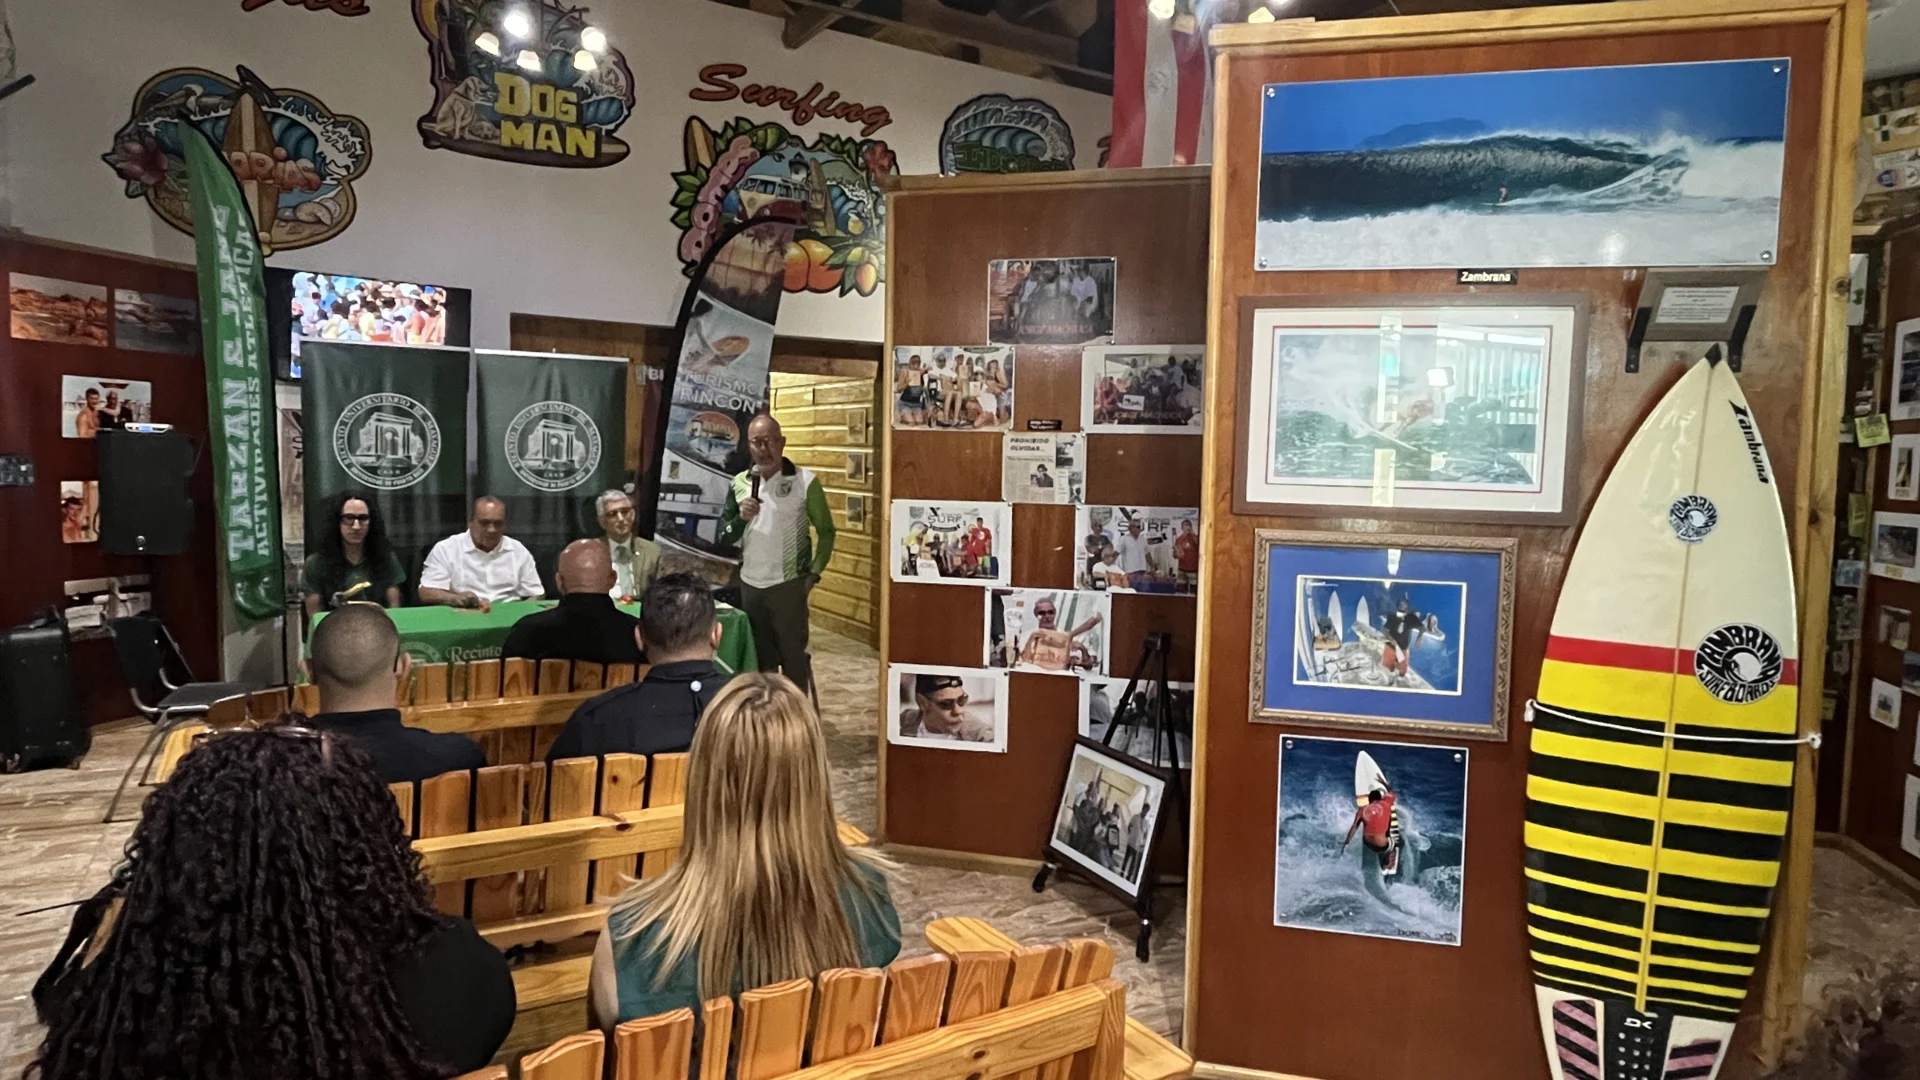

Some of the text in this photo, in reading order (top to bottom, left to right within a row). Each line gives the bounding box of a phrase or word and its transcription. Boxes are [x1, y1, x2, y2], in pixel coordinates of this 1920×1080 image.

[494, 72, 577, 123] DOG
[689, 63, 893, 137] Surfing
[501, 120, 596, 159] MAN
[1460, 271, 1512, 282] Zambrana
[223, 337, 244, 368] &
[684, 371, 759, 394] TURISMO
[1728, 399, 1769, 484] Zambrana
[222, 378, 256, 562] TARZAN
[247, 376, 270, 556] ACTIVIDADES
[928, 513, 962, 525] SURF
[1669, 494, 1718, 529] ZAMBRANA
[451, 643, 502, 662] Recinto
[1696, 625, 1781, 683] ZAMBRANA
[1697, 669, 1779, 703] SURFBOARDS
